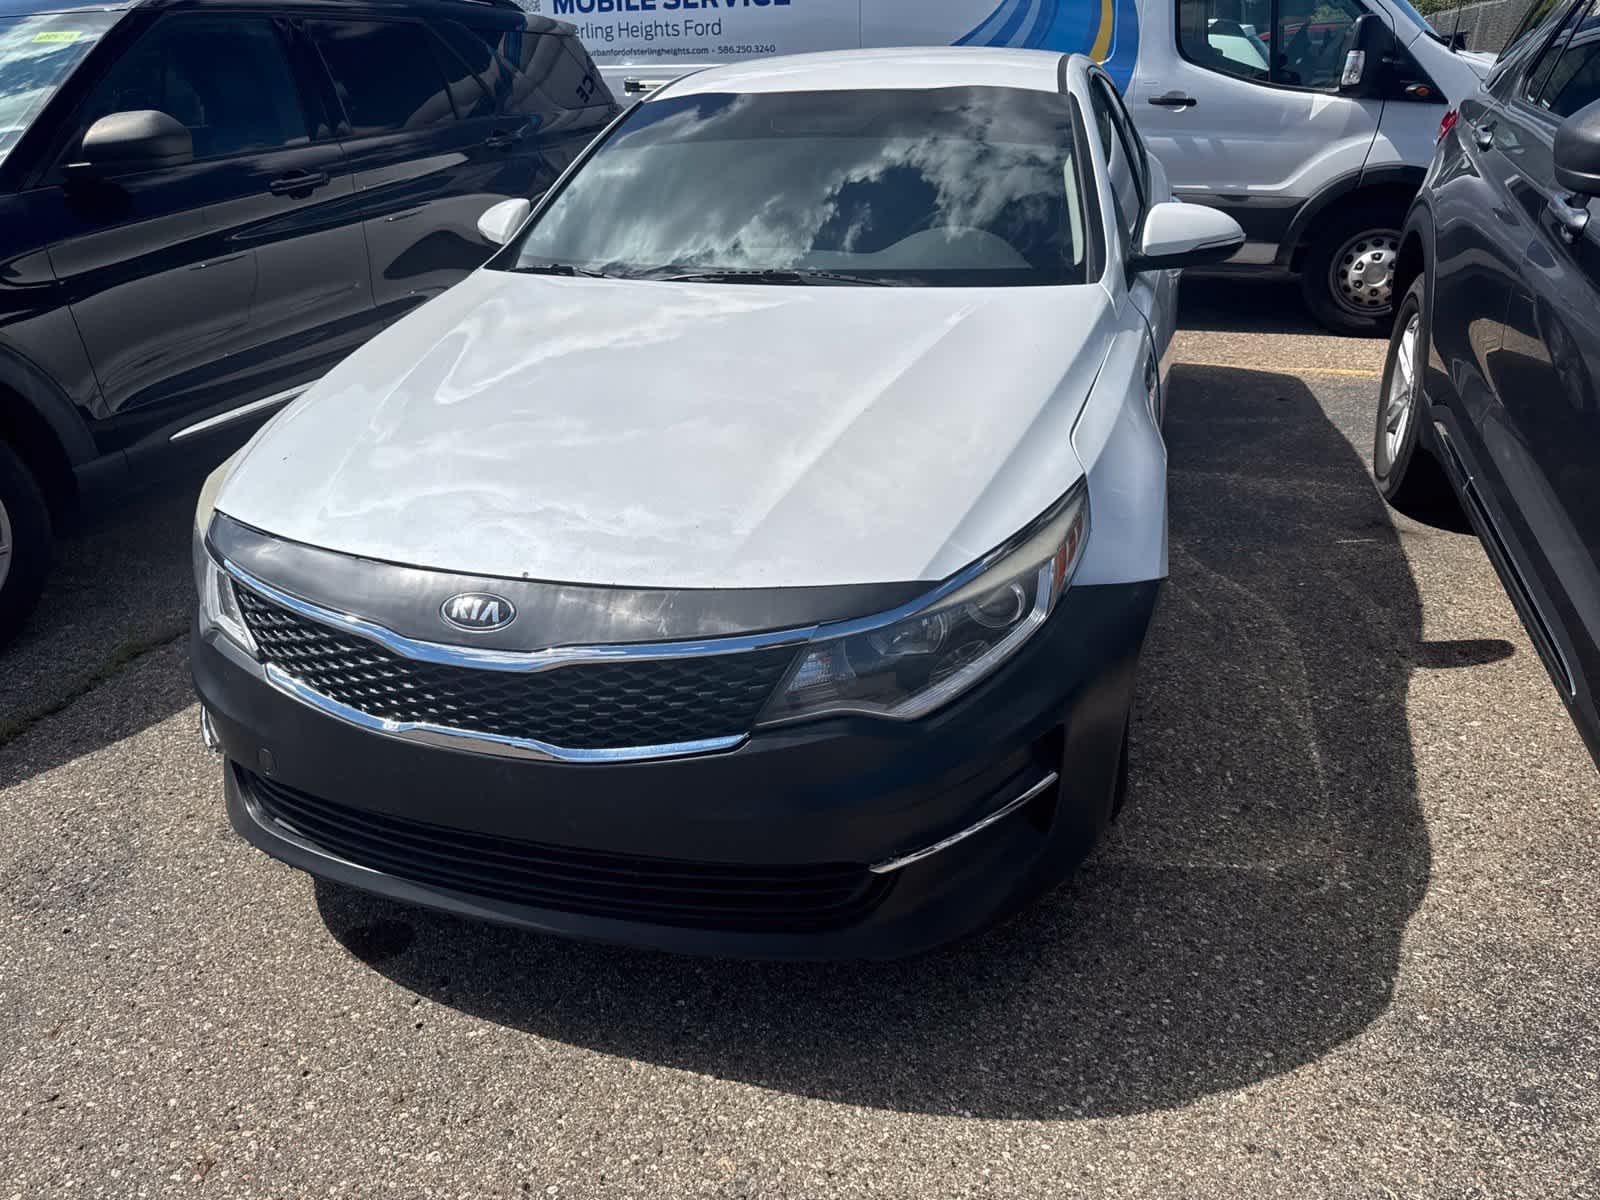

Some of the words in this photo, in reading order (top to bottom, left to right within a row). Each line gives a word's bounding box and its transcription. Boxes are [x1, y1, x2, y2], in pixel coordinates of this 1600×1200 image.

[575, 22, 614, 42] erling
[618, 20, 680, 41] Heights
[684, 18, 721, 37] Ford
[451, 598, 500, 622] KIA
